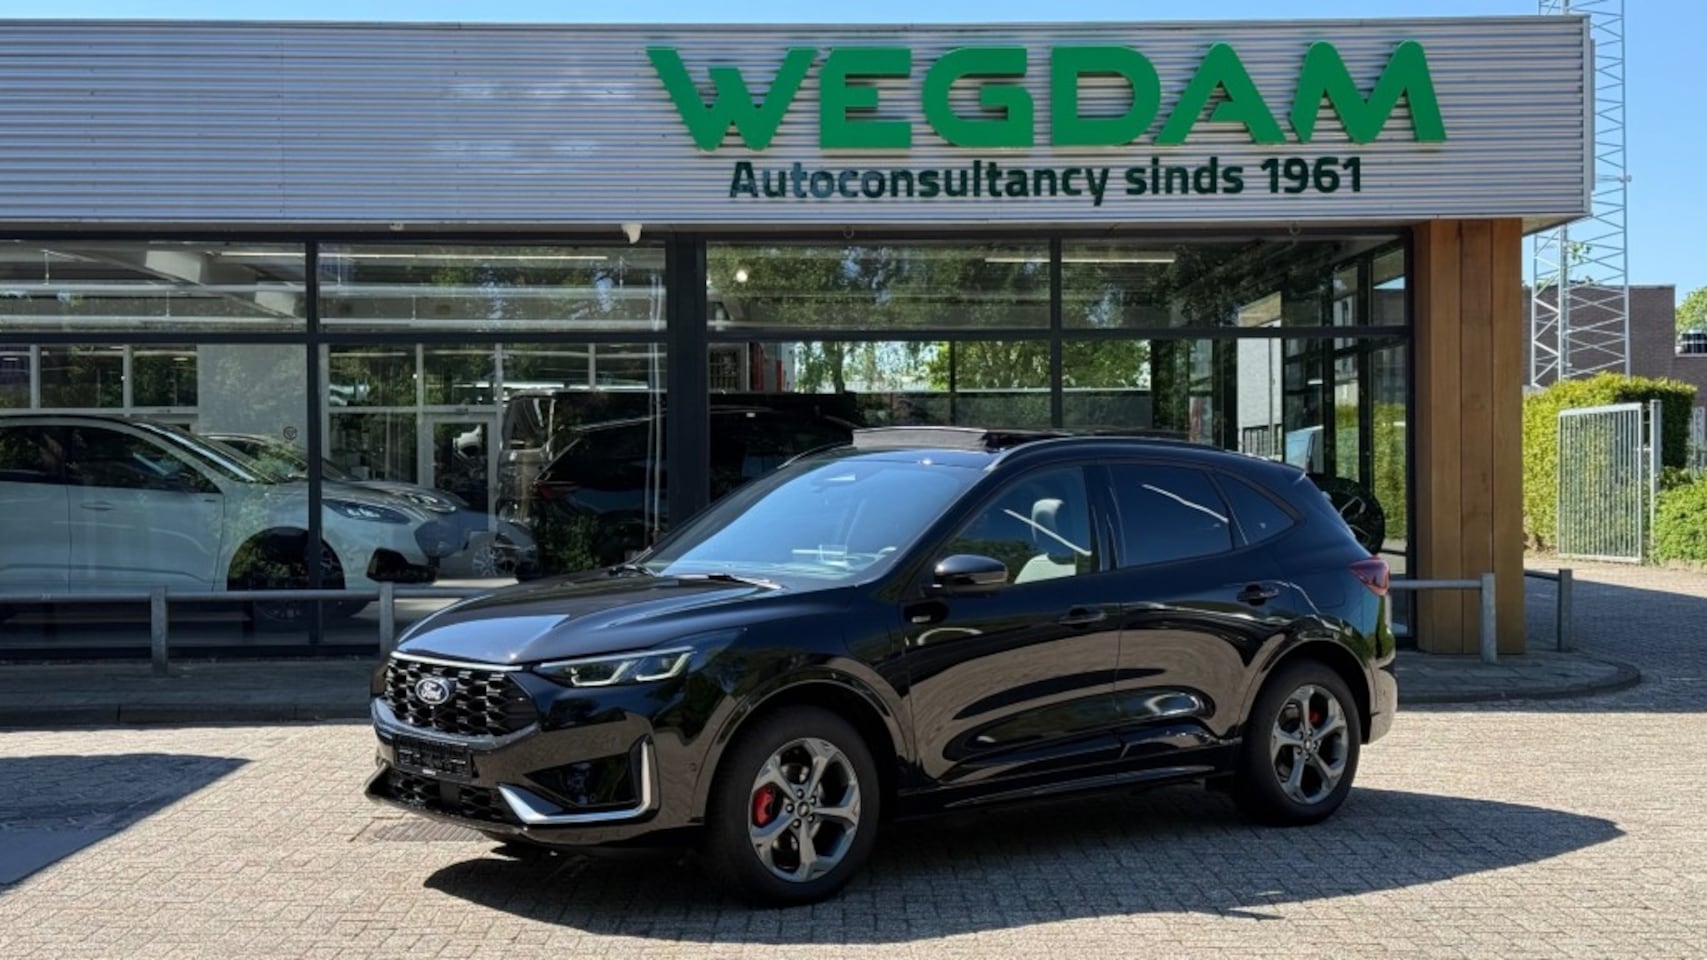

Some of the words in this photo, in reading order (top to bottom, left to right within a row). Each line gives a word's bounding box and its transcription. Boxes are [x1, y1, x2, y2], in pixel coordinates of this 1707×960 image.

[646, 41, 1446, 151] WEGDAM
[729, 160, 1109, 206] Autoconsultancy
[1126, 157, 1245, 194] sinds
[1260, 157, 1362, 193] 1961
